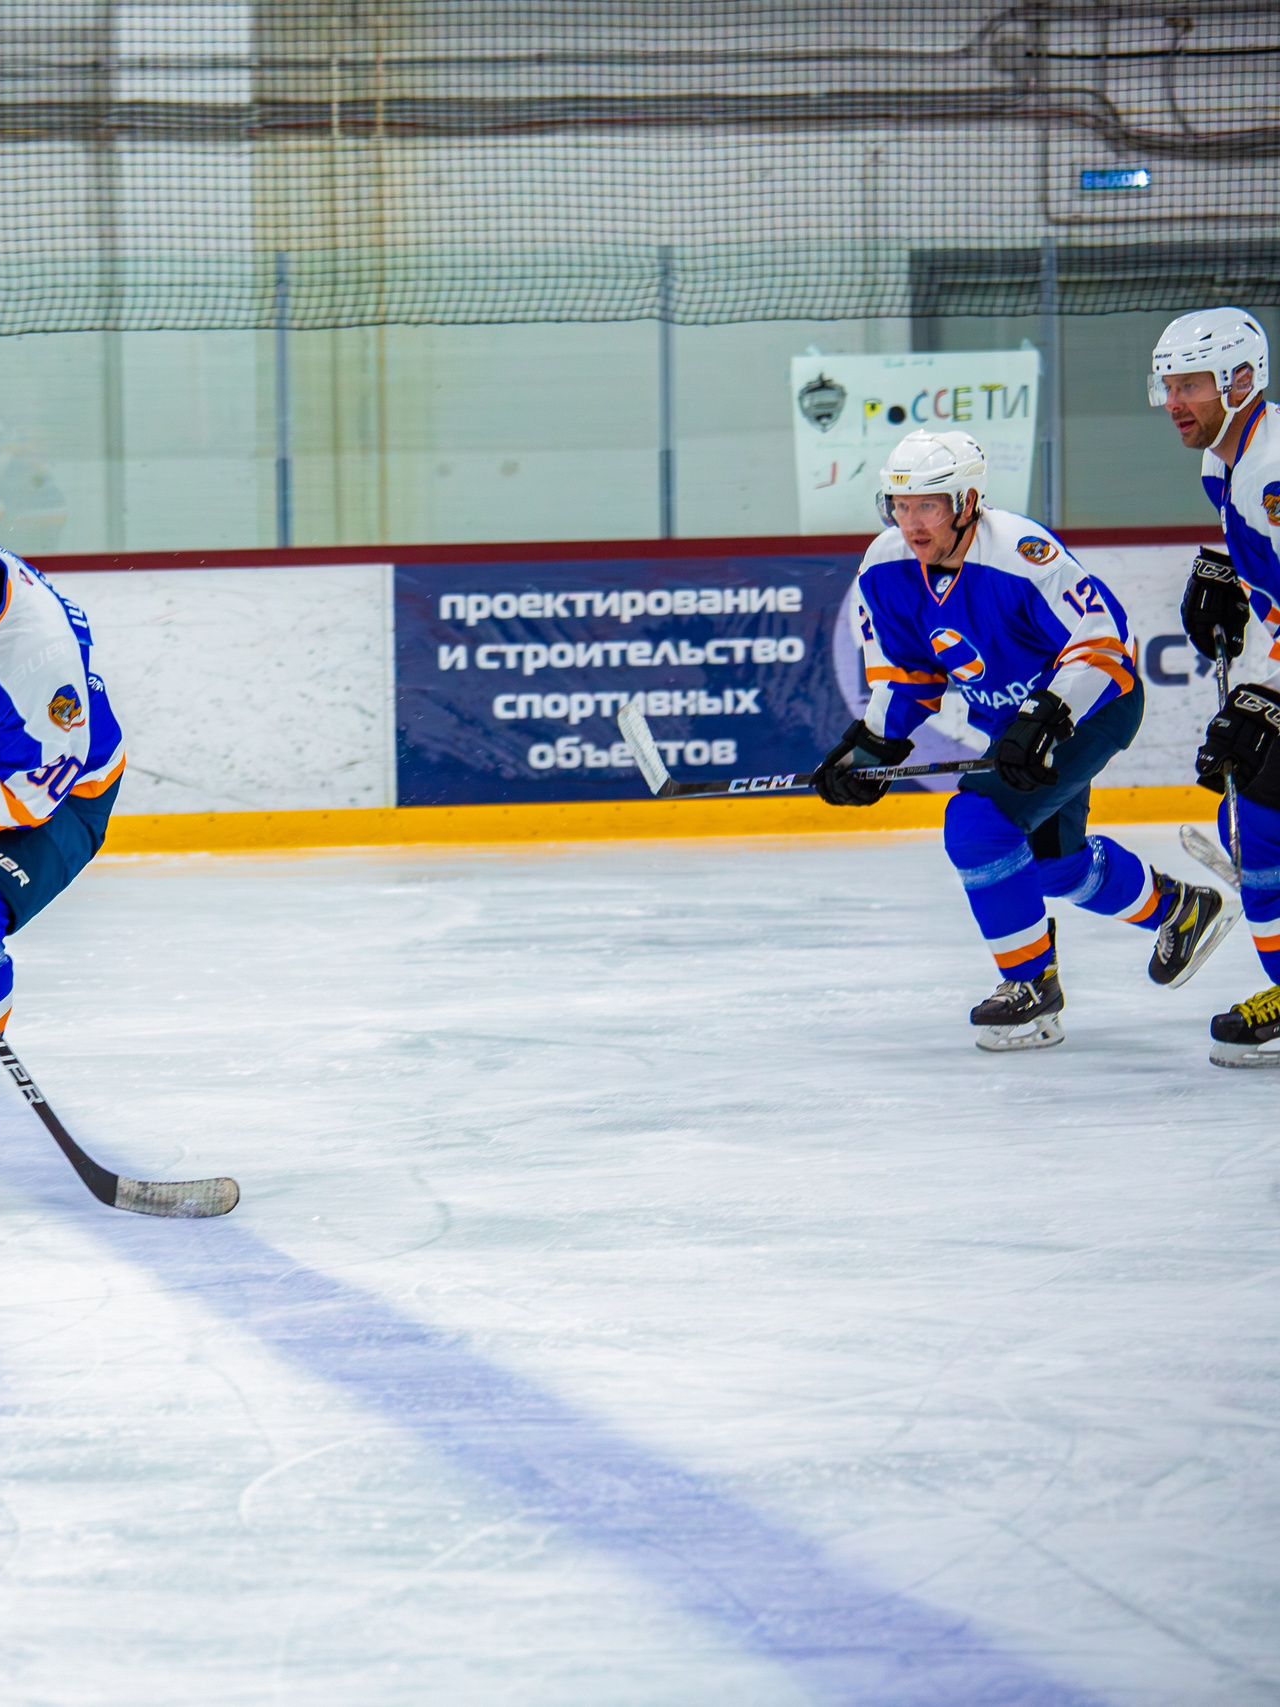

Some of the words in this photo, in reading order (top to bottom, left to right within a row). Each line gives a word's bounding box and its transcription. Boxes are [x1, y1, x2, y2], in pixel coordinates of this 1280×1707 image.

[439, 585, 803, 627] проектирование
[1062, 577, 1105, 620] 12
[437, 645, 468, 671] и
[475, 635, 805, 676] строительство
[492, 688, 762, 725] спортивных
[527, 736, 738, 770] объетов
[728, 773, 796, 793] CCM
